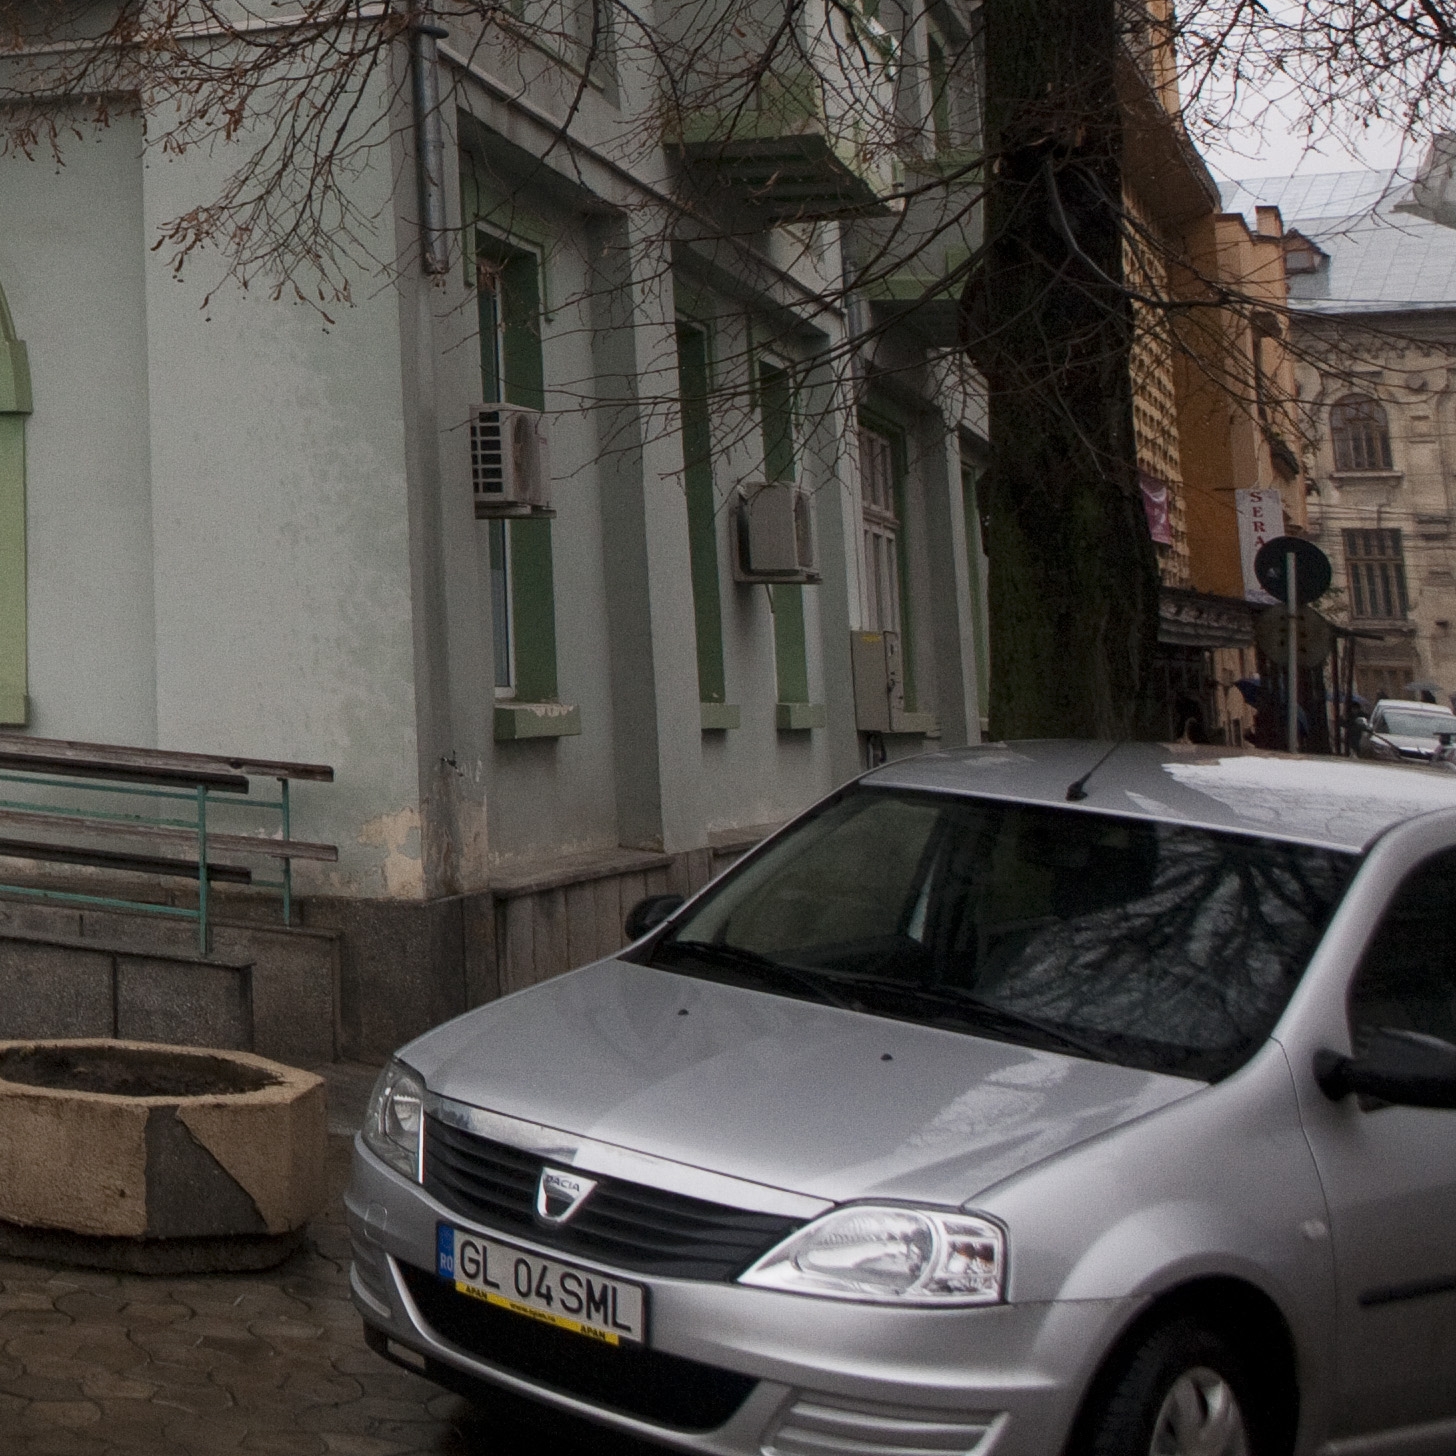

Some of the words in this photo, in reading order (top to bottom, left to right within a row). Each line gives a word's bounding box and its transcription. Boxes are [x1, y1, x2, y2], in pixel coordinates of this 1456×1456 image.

[545, 1174, 580, 1192] DACIA
[440, 1252, 454, 1272] RO
[460, 1239, 501, 1290] GL
[465, 1284, 488, 1300] APAN
[579, 1324, 606, 1341] APAN
